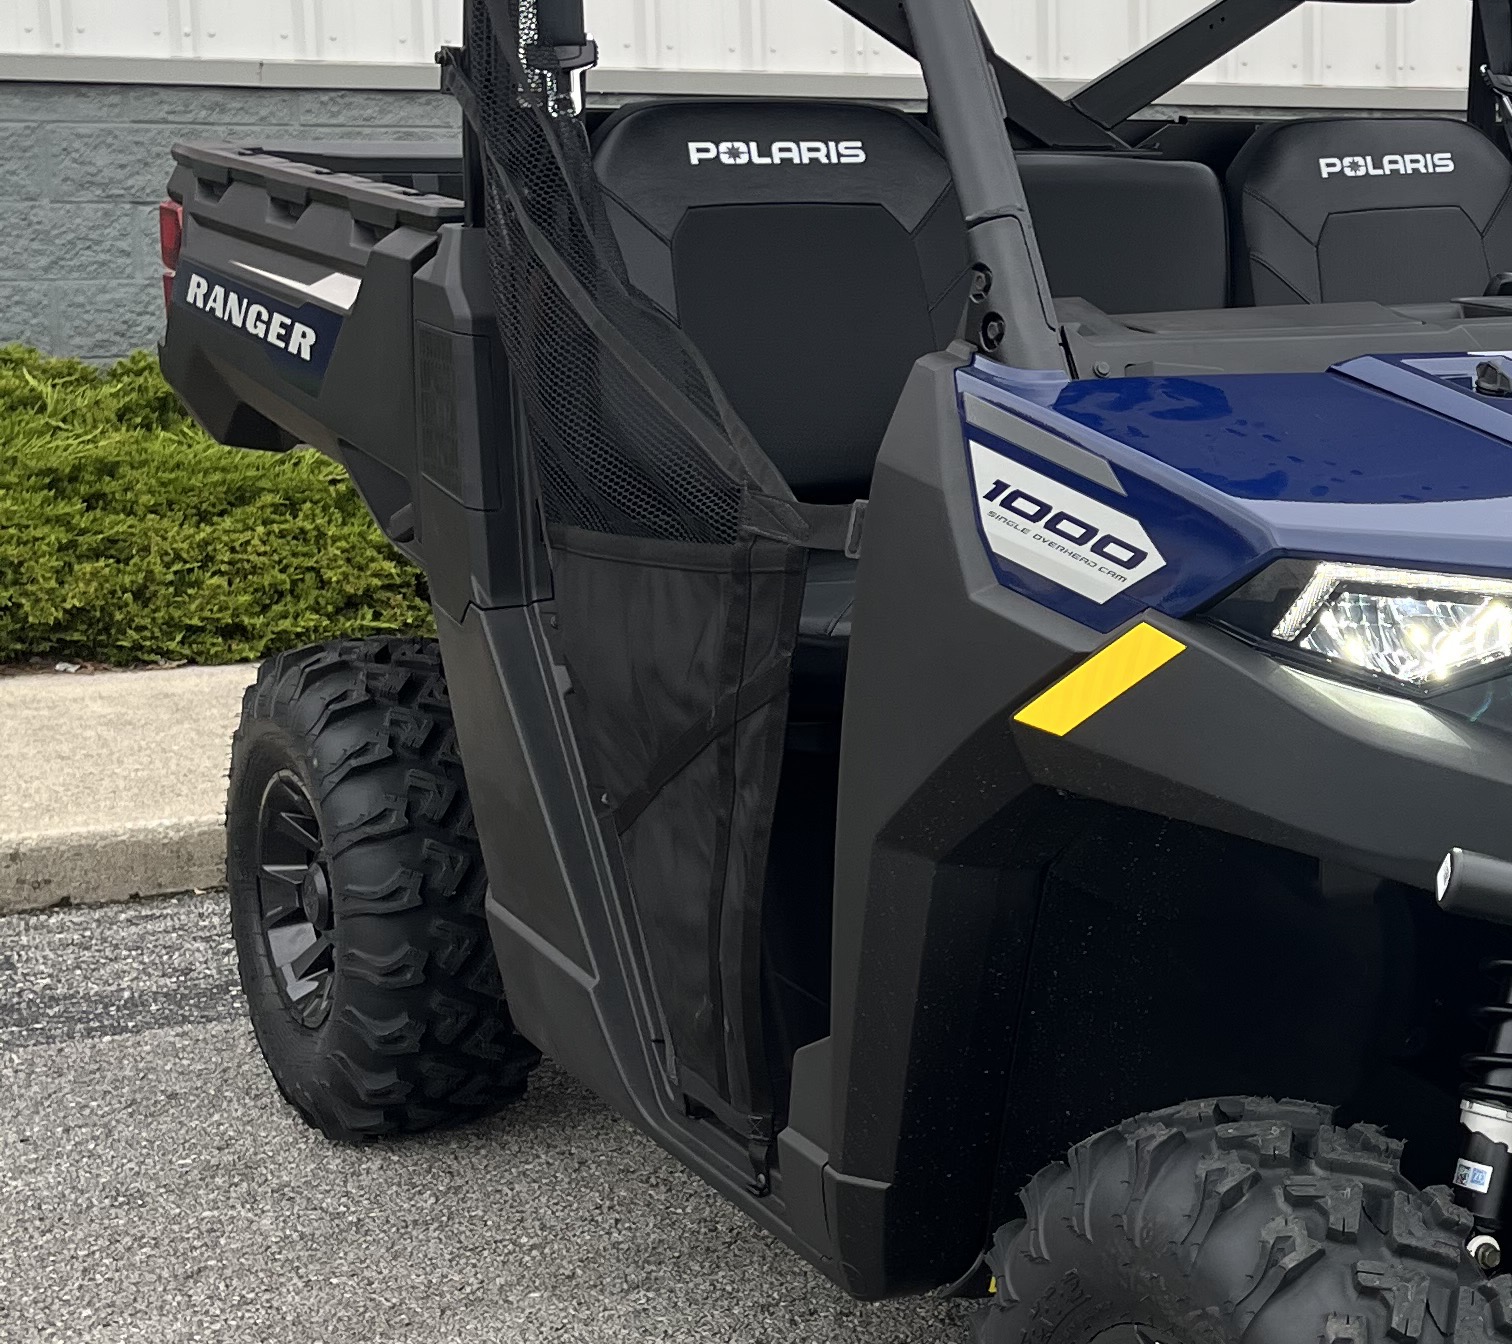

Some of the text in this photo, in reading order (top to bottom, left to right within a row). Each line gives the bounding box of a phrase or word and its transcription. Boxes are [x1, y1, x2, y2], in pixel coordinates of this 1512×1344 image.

[687, 140, 867, 165] POLARIS
[1318, 152, 1455, 179] POLARIS
[186, 272, 317, 361] RANGER
[982, 478, 1149, 571] 1000
[987, 509, 1128, 584] SINGLE OVERHEAD CAM
